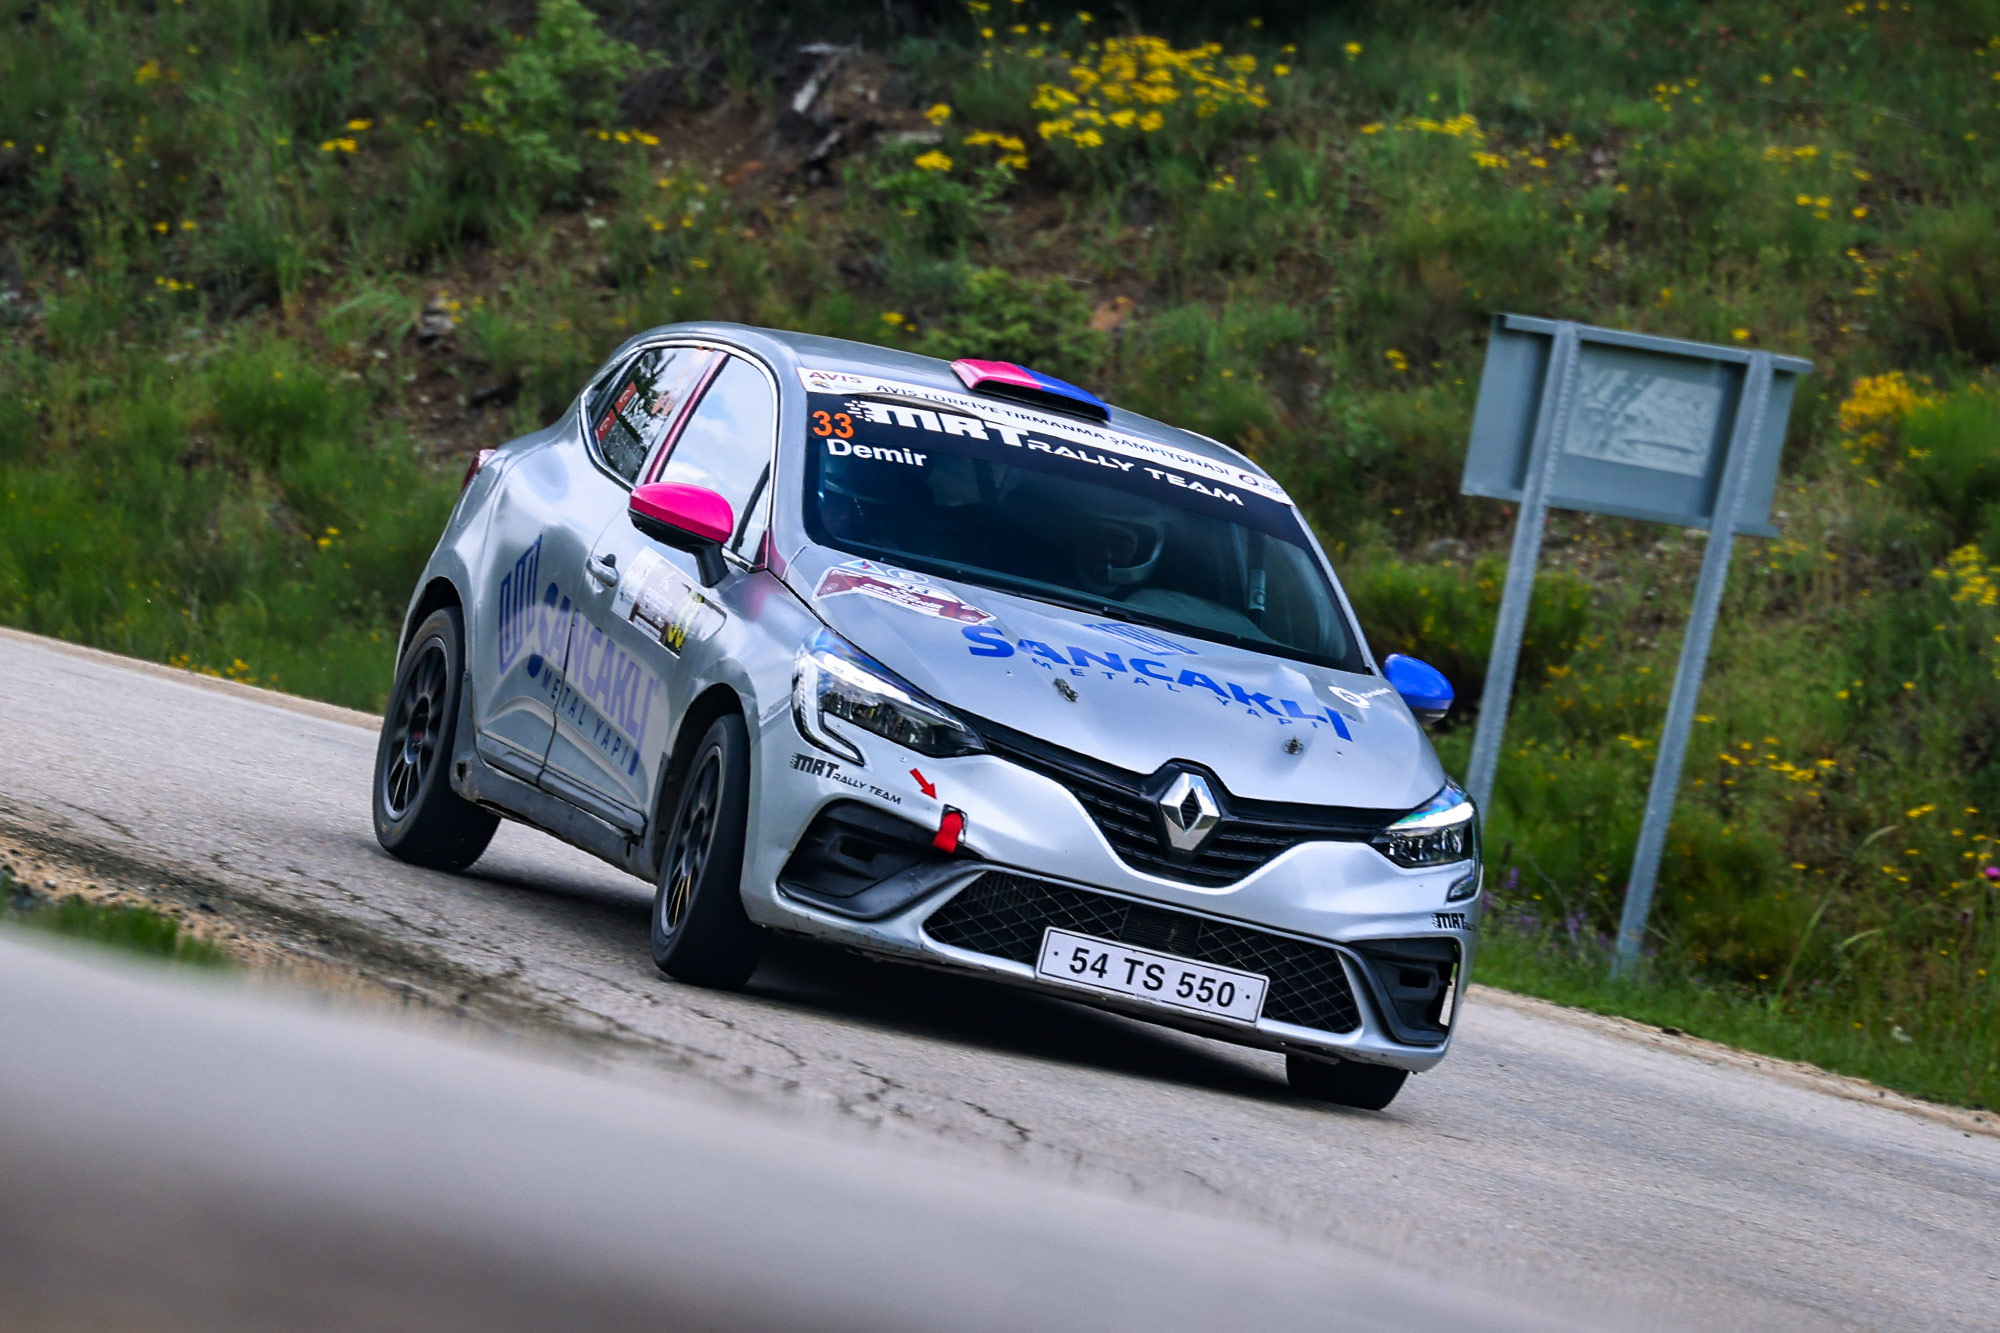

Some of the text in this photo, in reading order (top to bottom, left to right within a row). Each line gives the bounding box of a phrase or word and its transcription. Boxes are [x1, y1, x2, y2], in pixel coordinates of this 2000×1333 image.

[809, 371, 862, 384] AVIS
[812, 410, 855, 439] 33
[876, 385, 917, 397] AVIS
[1002, 409, 1105, 440] TIRMANMA
[826, 438, 927, 467] Demir
[1144, 467, 1244, 506] TEAM
[961, 625, 1353, 743] SANCAKLI
[1031, 657, 1318, 729] METAL YAPI
[541, 667, 629, 766] METAL YAPI
[869, 785, 901, 805] TEAM
[1434, 912, 1465, 929] MRT
[1069, 946, 1235, 1008] 54 TS 550
